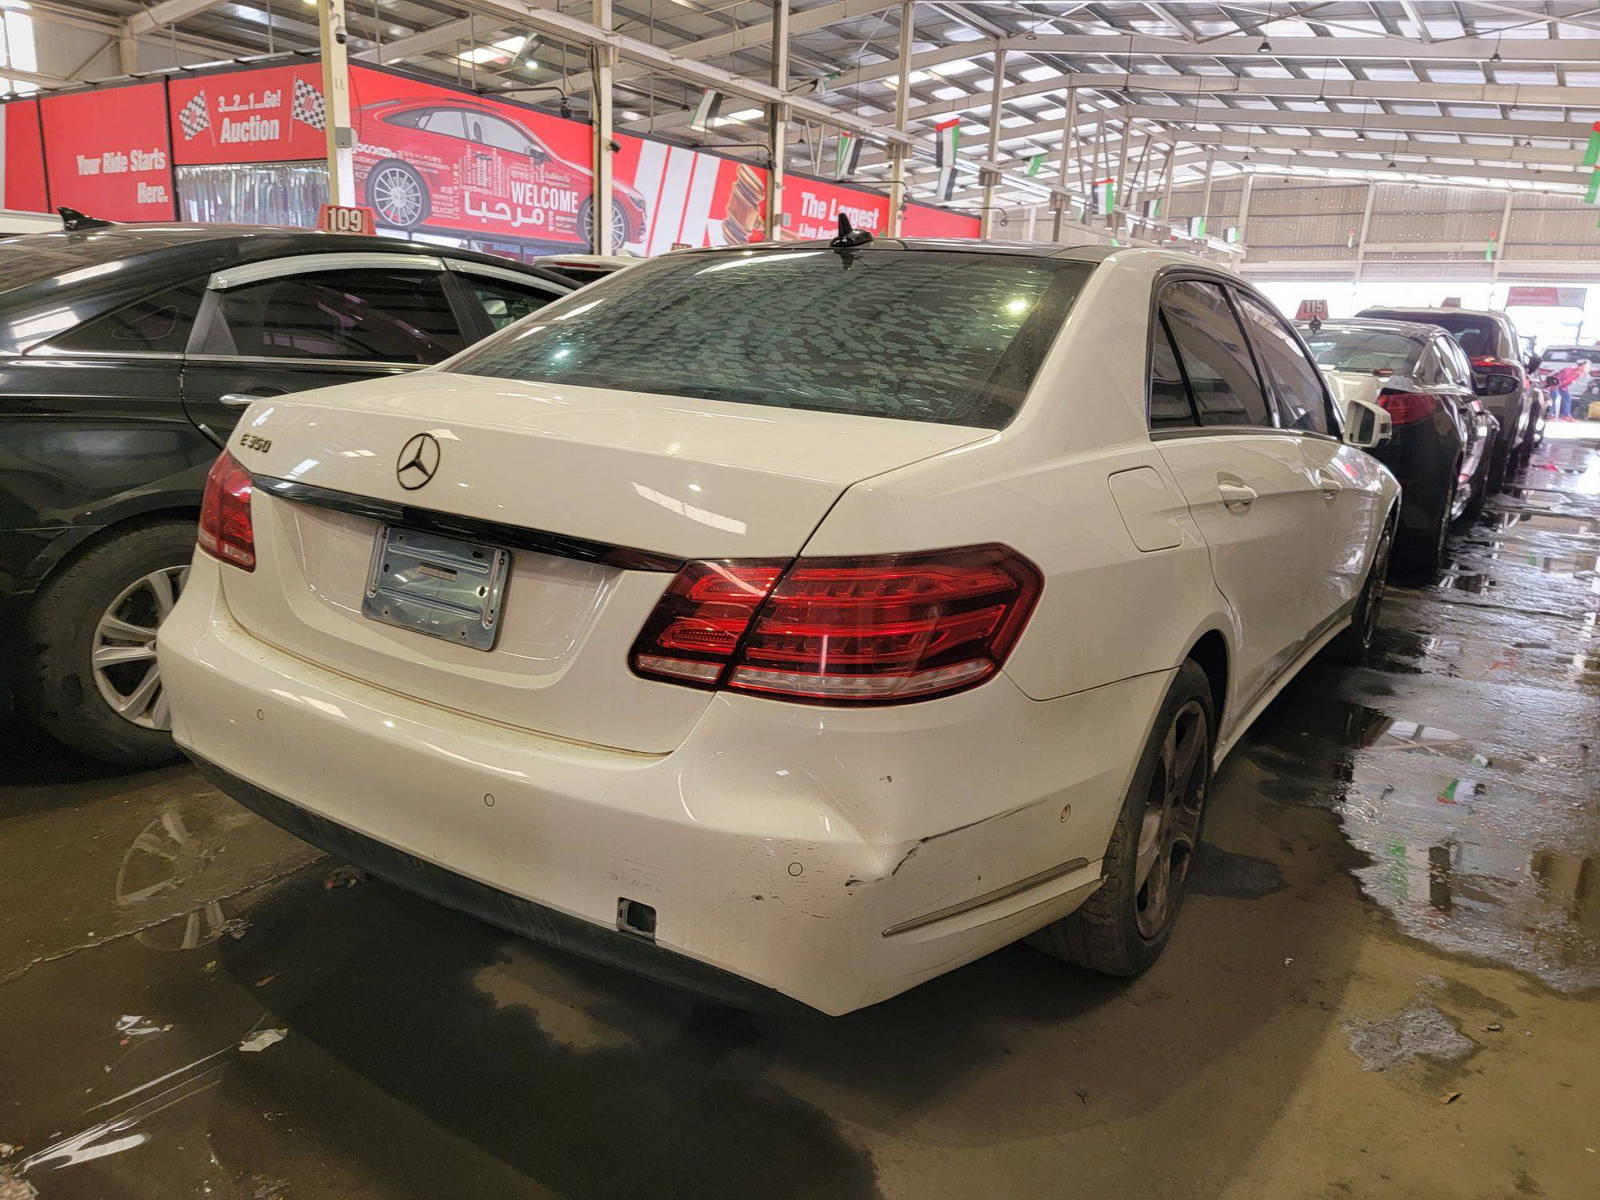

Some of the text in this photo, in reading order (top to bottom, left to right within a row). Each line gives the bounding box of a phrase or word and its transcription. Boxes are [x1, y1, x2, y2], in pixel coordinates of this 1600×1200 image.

[220, 115, 280, 143] Auction
[77, 148, 166, 175] Your Ride Starts
[137, 182, 169, 203] Here.
[511, 181, 579, 213] WELCOME
[802, 192, 826, 219] The
[327, 207, 362, 233] 109
[464, 190, 545, 228] مرحبا
[1304, 299, 1323, 313] 115
[240, 435, 272, 453] E 350
